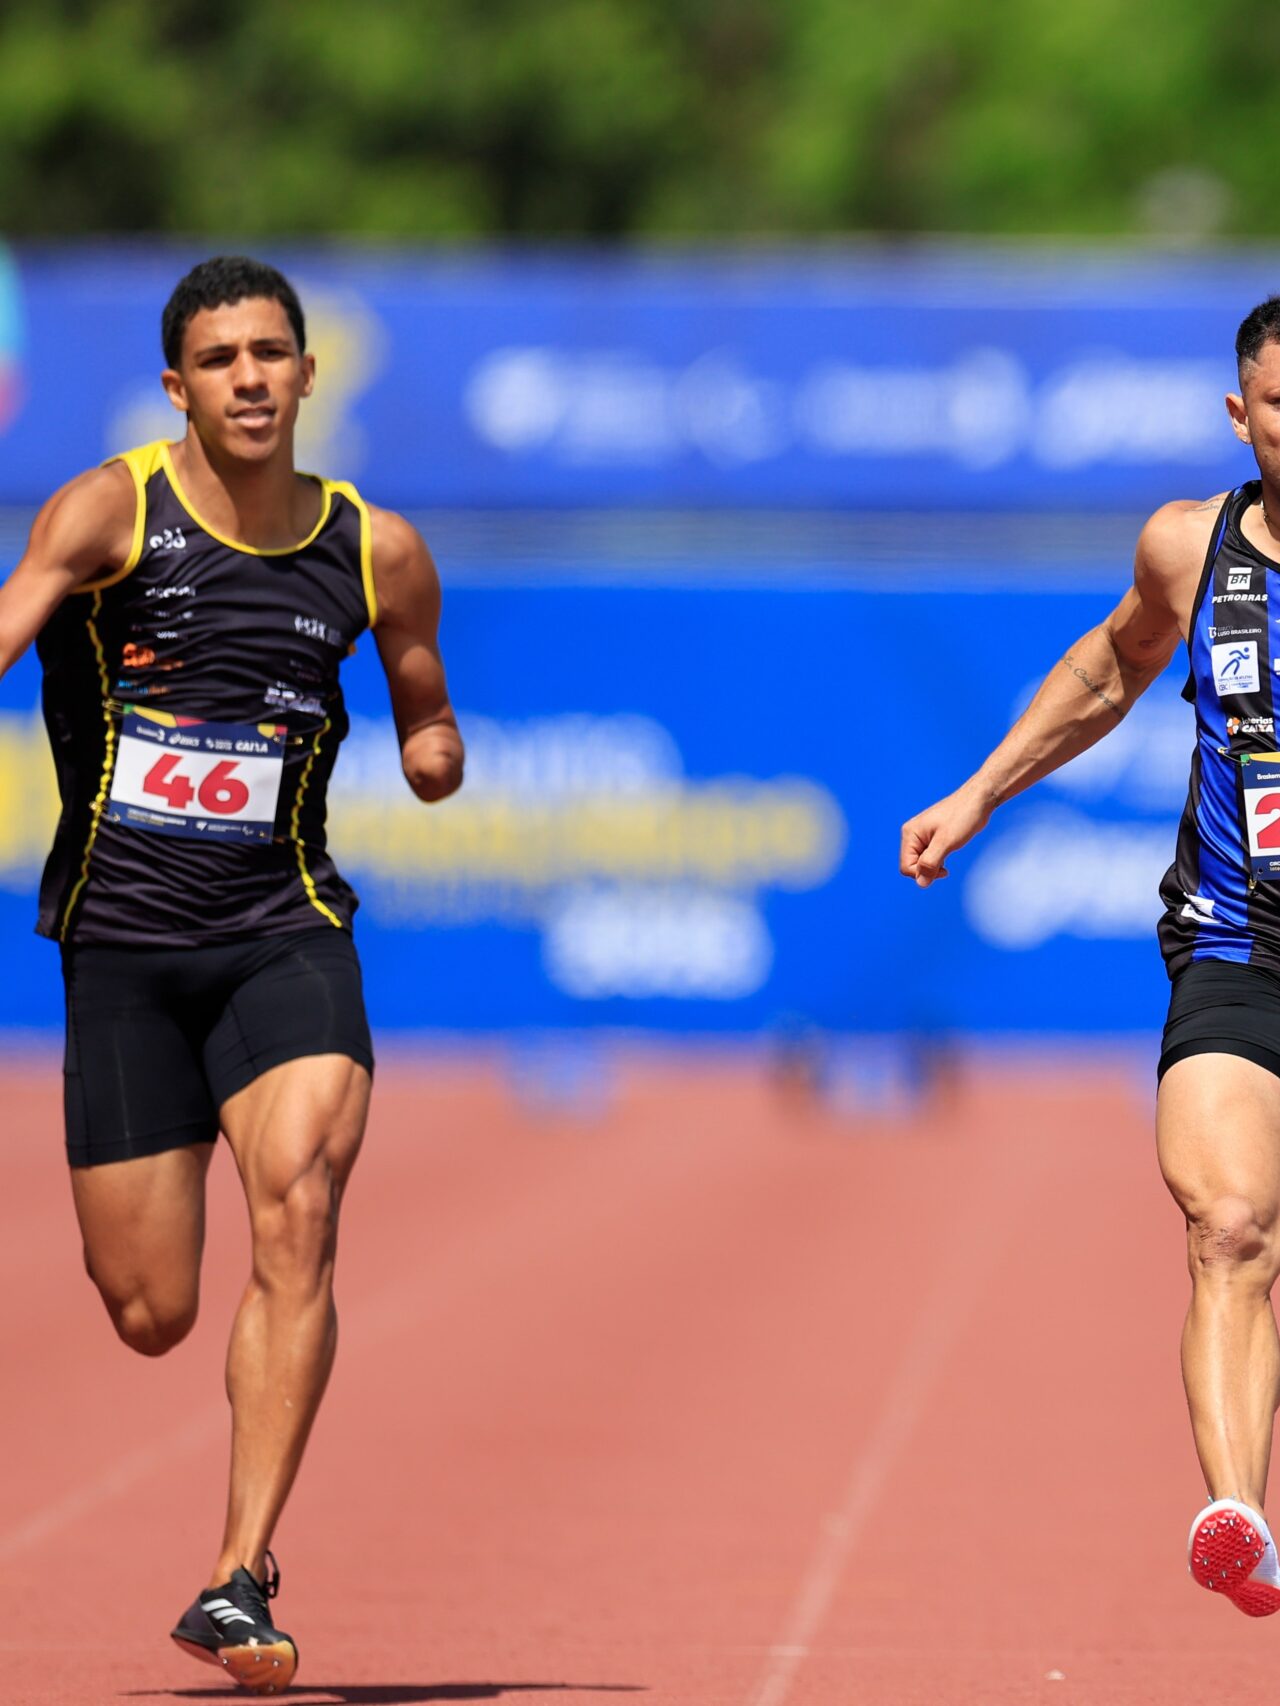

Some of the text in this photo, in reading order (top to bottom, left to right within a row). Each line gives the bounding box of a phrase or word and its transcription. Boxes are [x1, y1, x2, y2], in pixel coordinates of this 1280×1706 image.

[1211, 594, 1268, 603] PETROBRAS
[1230, 628, 1262, 636] BRASILEIRO
[1241, 716, 1274, 725] loterias
[1241, 724, 1275, 733] CAIXA
[142, 753, 249, 815] 46
